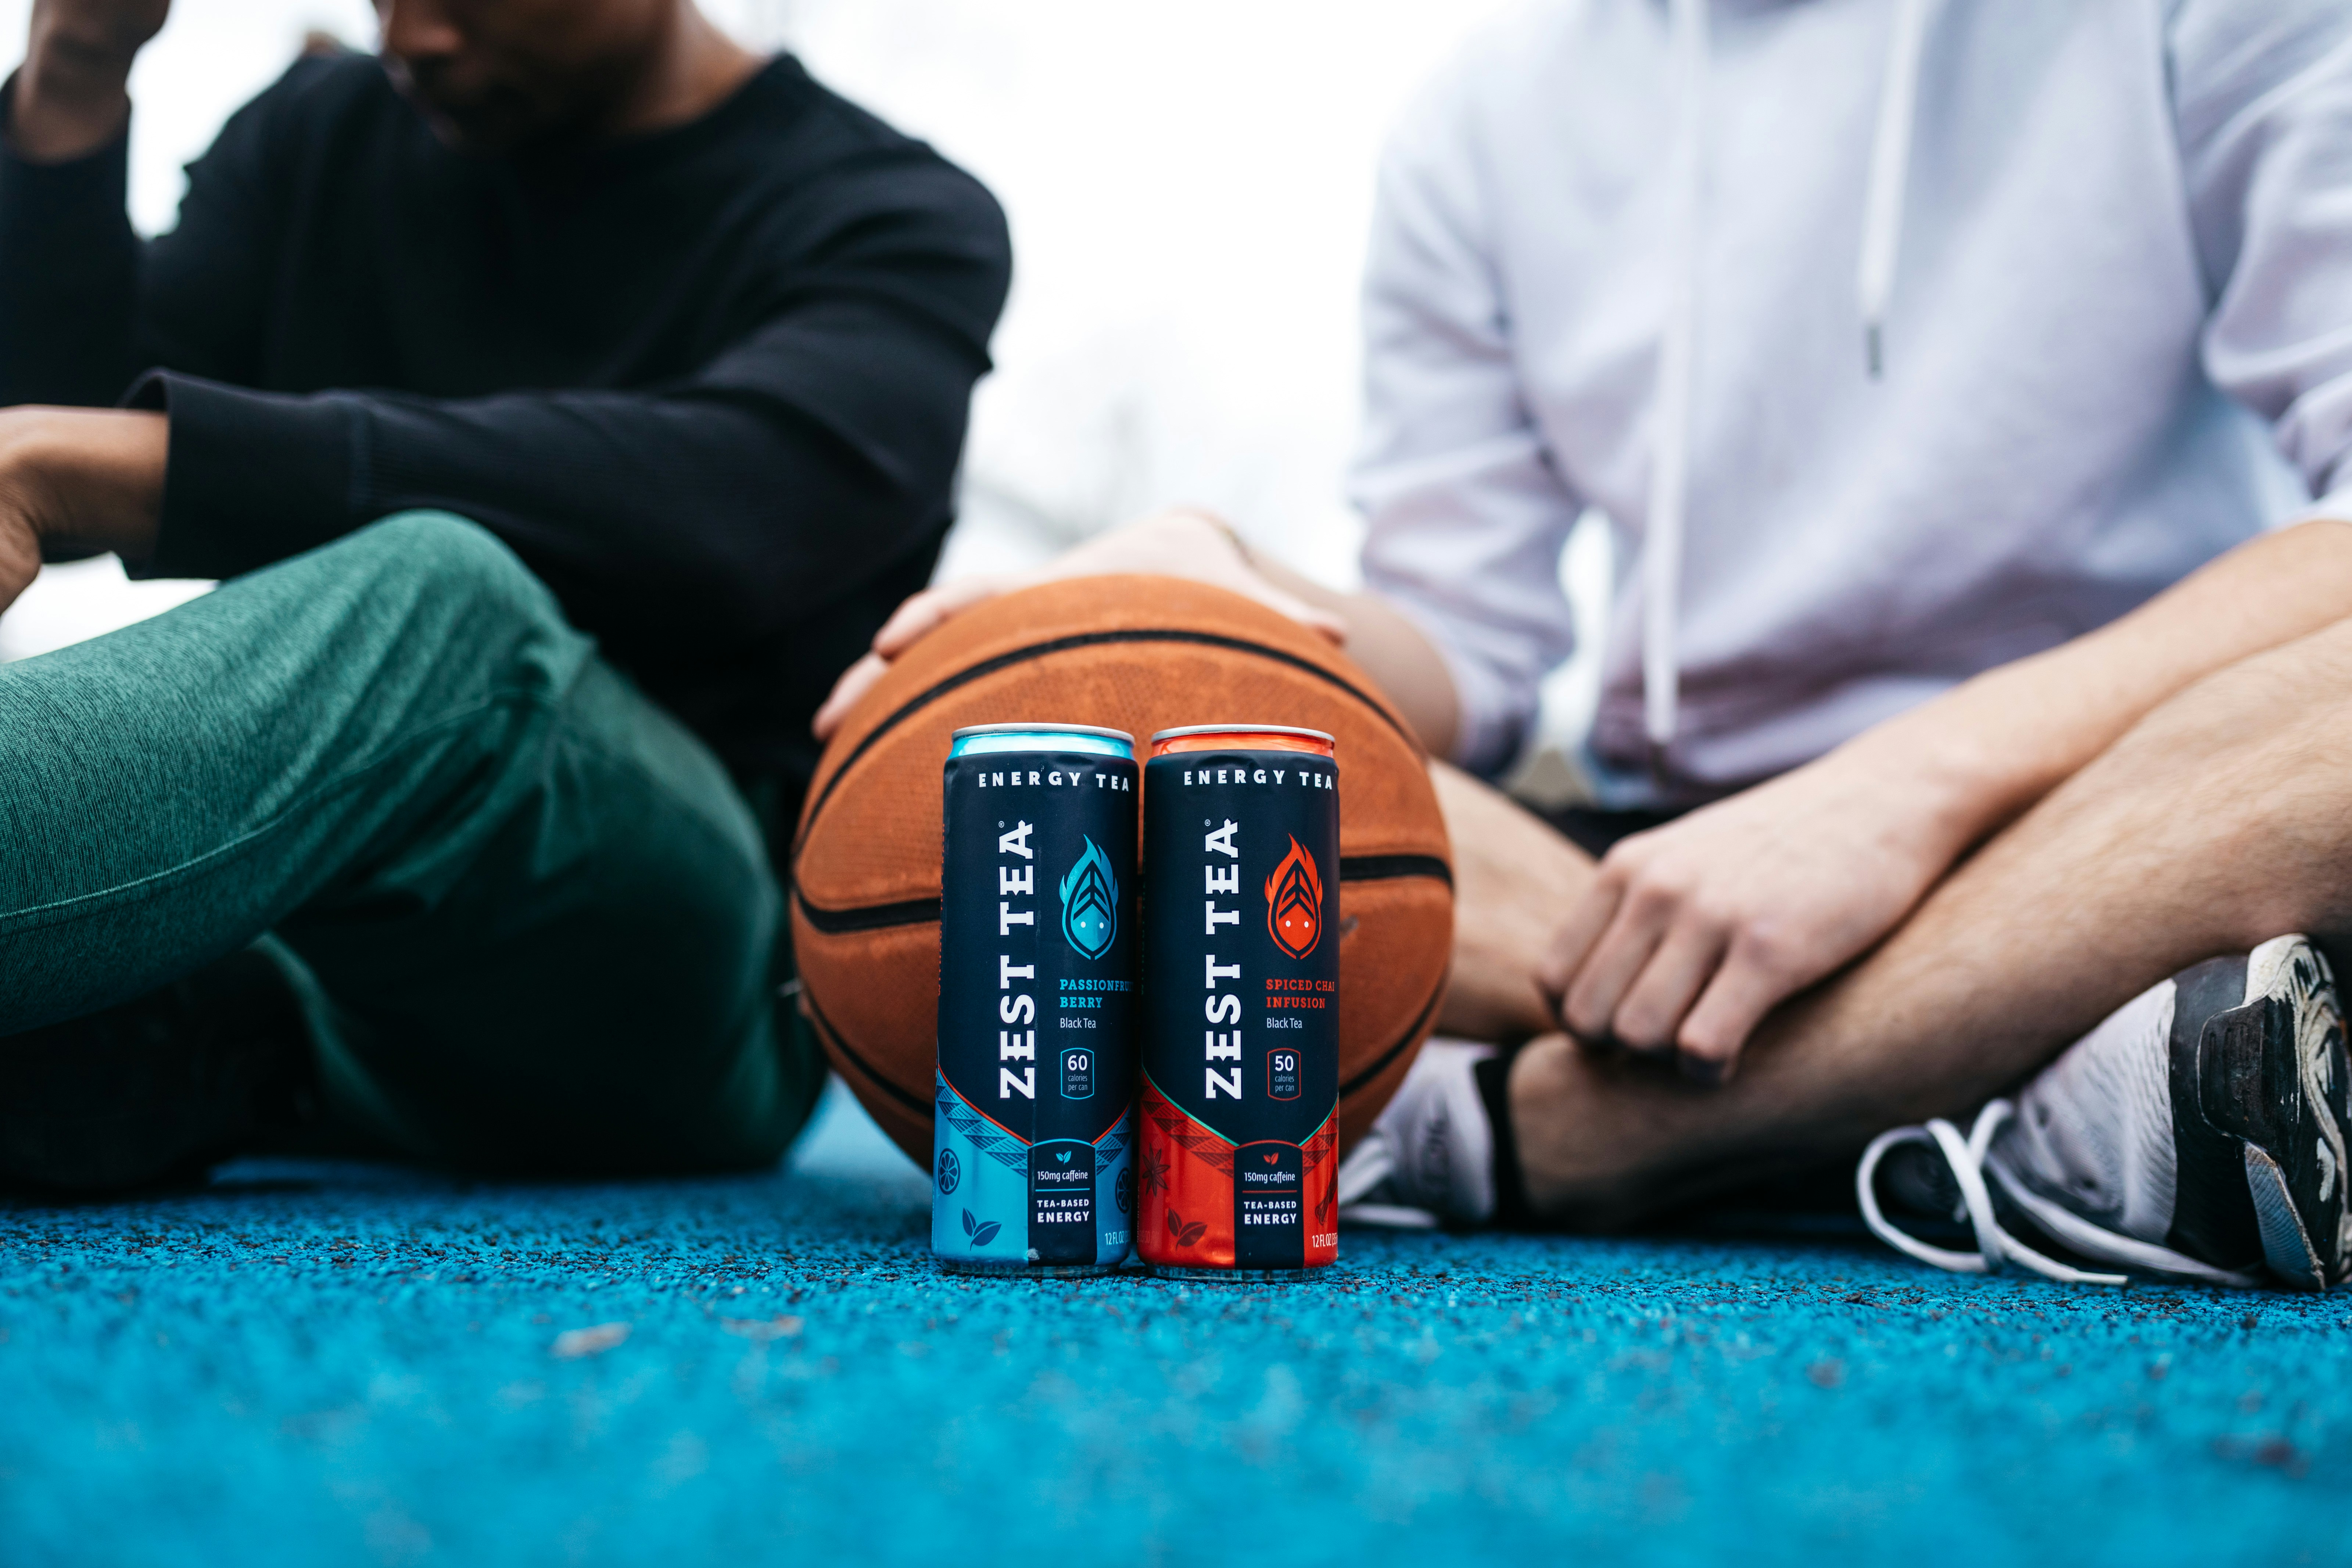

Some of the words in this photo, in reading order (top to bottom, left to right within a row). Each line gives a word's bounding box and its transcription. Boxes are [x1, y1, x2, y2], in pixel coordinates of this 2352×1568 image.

[979, 771, 1081, 787] ENERGY
[1096, 774, 1128, 791] TEA
[1184, 769, 1285, 785] ENERGY
[1299, 772, 1332, 789] TEA
[1266, 979, 1312, 990] SPICED
[1316, 980, 1334, 991] CHAI
[1060, 997, 1102, 1008] BERRY
[1267, 997, 1325, 1008] INFUSION
[1000, 955, 1035, 1099] ZEST
[1061, 1018, 1082, 1028] Black
[1083, 1018, 1096, 1028] Tea
[1205, 955, 1241, 1099] ZEST
[1267, 1018, 1288, 1028] Black
[1290, 1018, 1302, 1028] Tea
[1068, 1055, 1087, 1070] 60
[1275, 1055, 1293, 1071] 50
[1038, 1171, 1060, 1182] 150mg
[1062, 1170, 1087, 1181] caffeine
[1245, 1173, 1268, 1183] 150mg
[1270, 1172, 1295, 1183] caffeine
[1037, 1199, 1089, 1208] TEA-BASED
[1038, 1211, 1089, 1222] ENERGY
[1245, 1214, 1296, 1224] ENERGY
[1105, 1233, 1112, 1245] 12
[1113, 1232, 1118, 1244] FL
[1119, 1231, 1123, 1243] OZ
[1312, 1235, 1319, 1247] 12
[1320, 1234, 1325, 1246] FL
[1326, 1234, 1331, 1246] OZ
